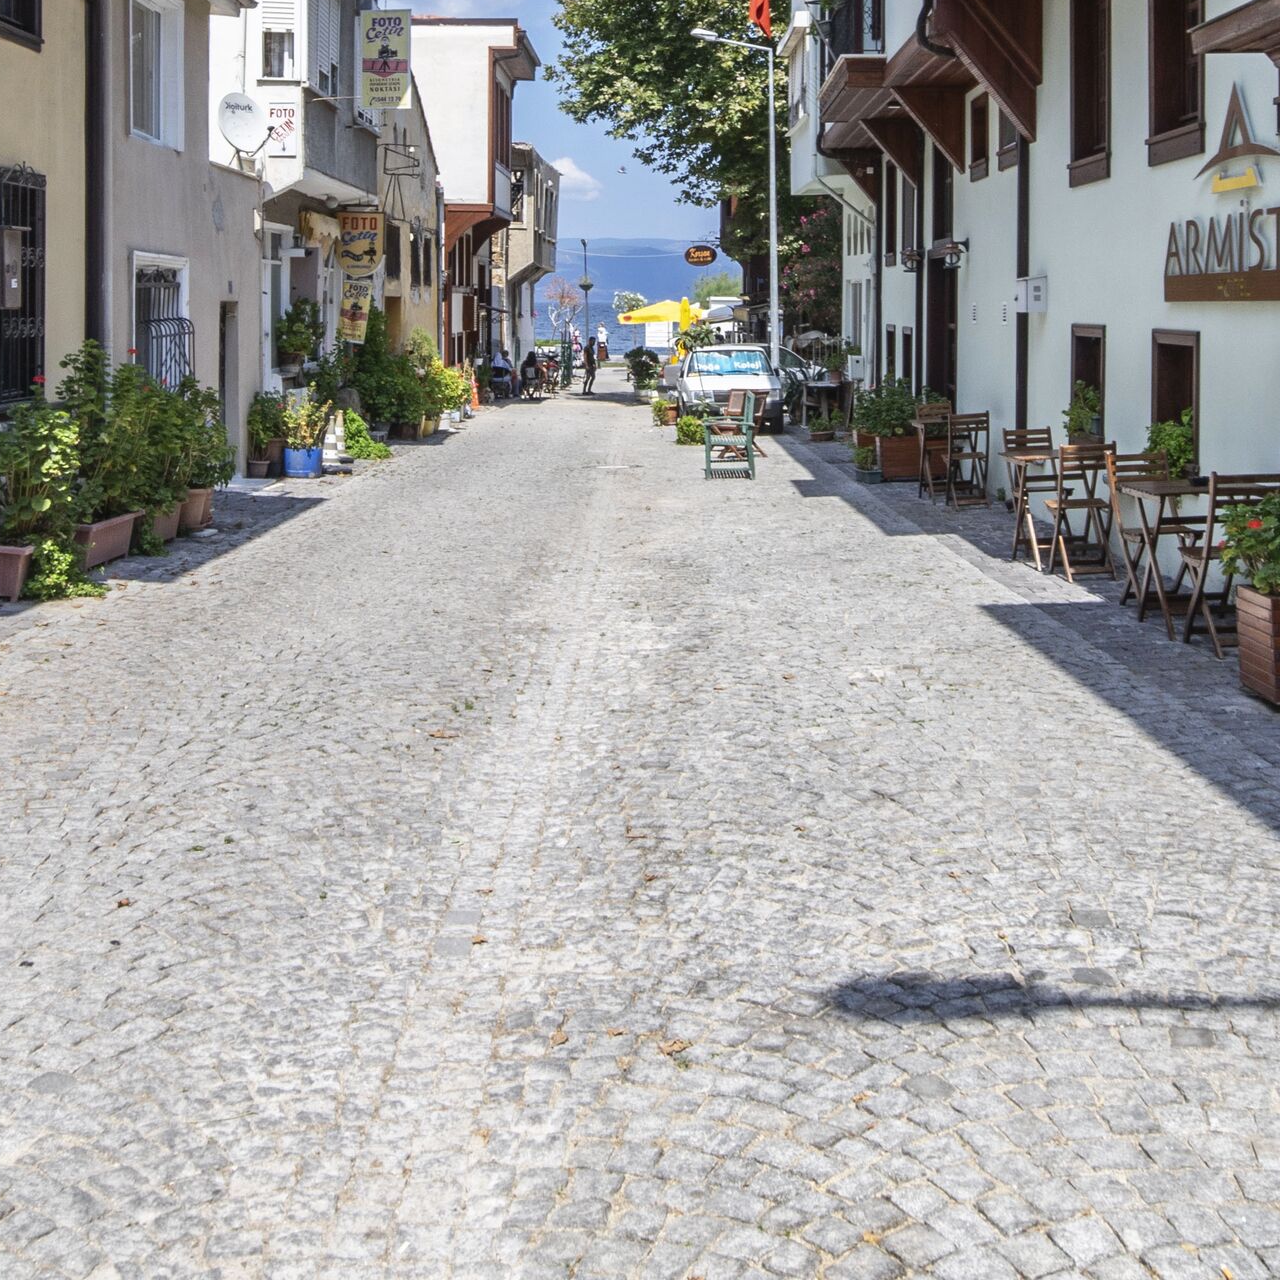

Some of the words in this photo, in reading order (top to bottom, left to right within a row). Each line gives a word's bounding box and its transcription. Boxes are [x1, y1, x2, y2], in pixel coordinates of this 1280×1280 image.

[371, 16, 402, 28] FOTO
[269, 108, 295, 118] FOTO
[342, 216, 377, 231] FOTO
[349, 283, 369, 293] FOTO
